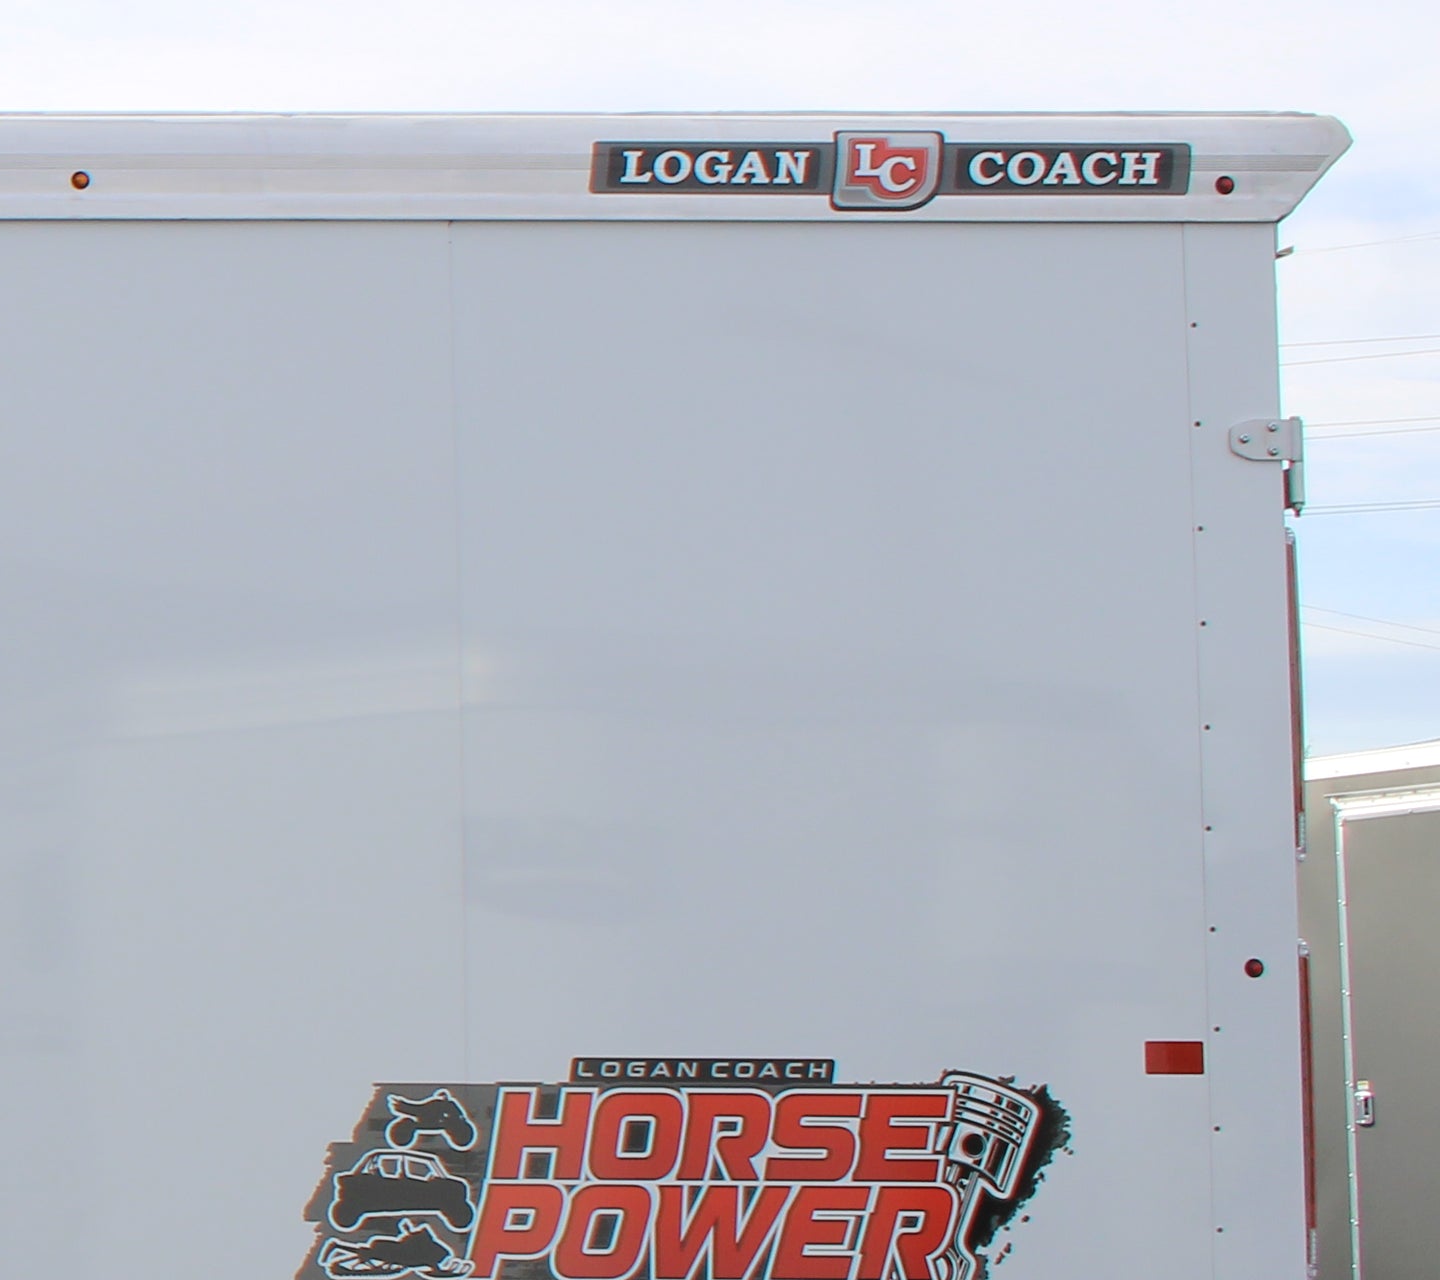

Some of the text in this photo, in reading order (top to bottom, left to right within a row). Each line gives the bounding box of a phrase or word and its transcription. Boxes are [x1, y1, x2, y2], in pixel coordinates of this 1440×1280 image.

[619, 143, 1162, 193] LOGAN LC COACH
[576, 1060, 828, 1079] LOGAN COACH
[487, 1086, 958, 1183] HORSE
